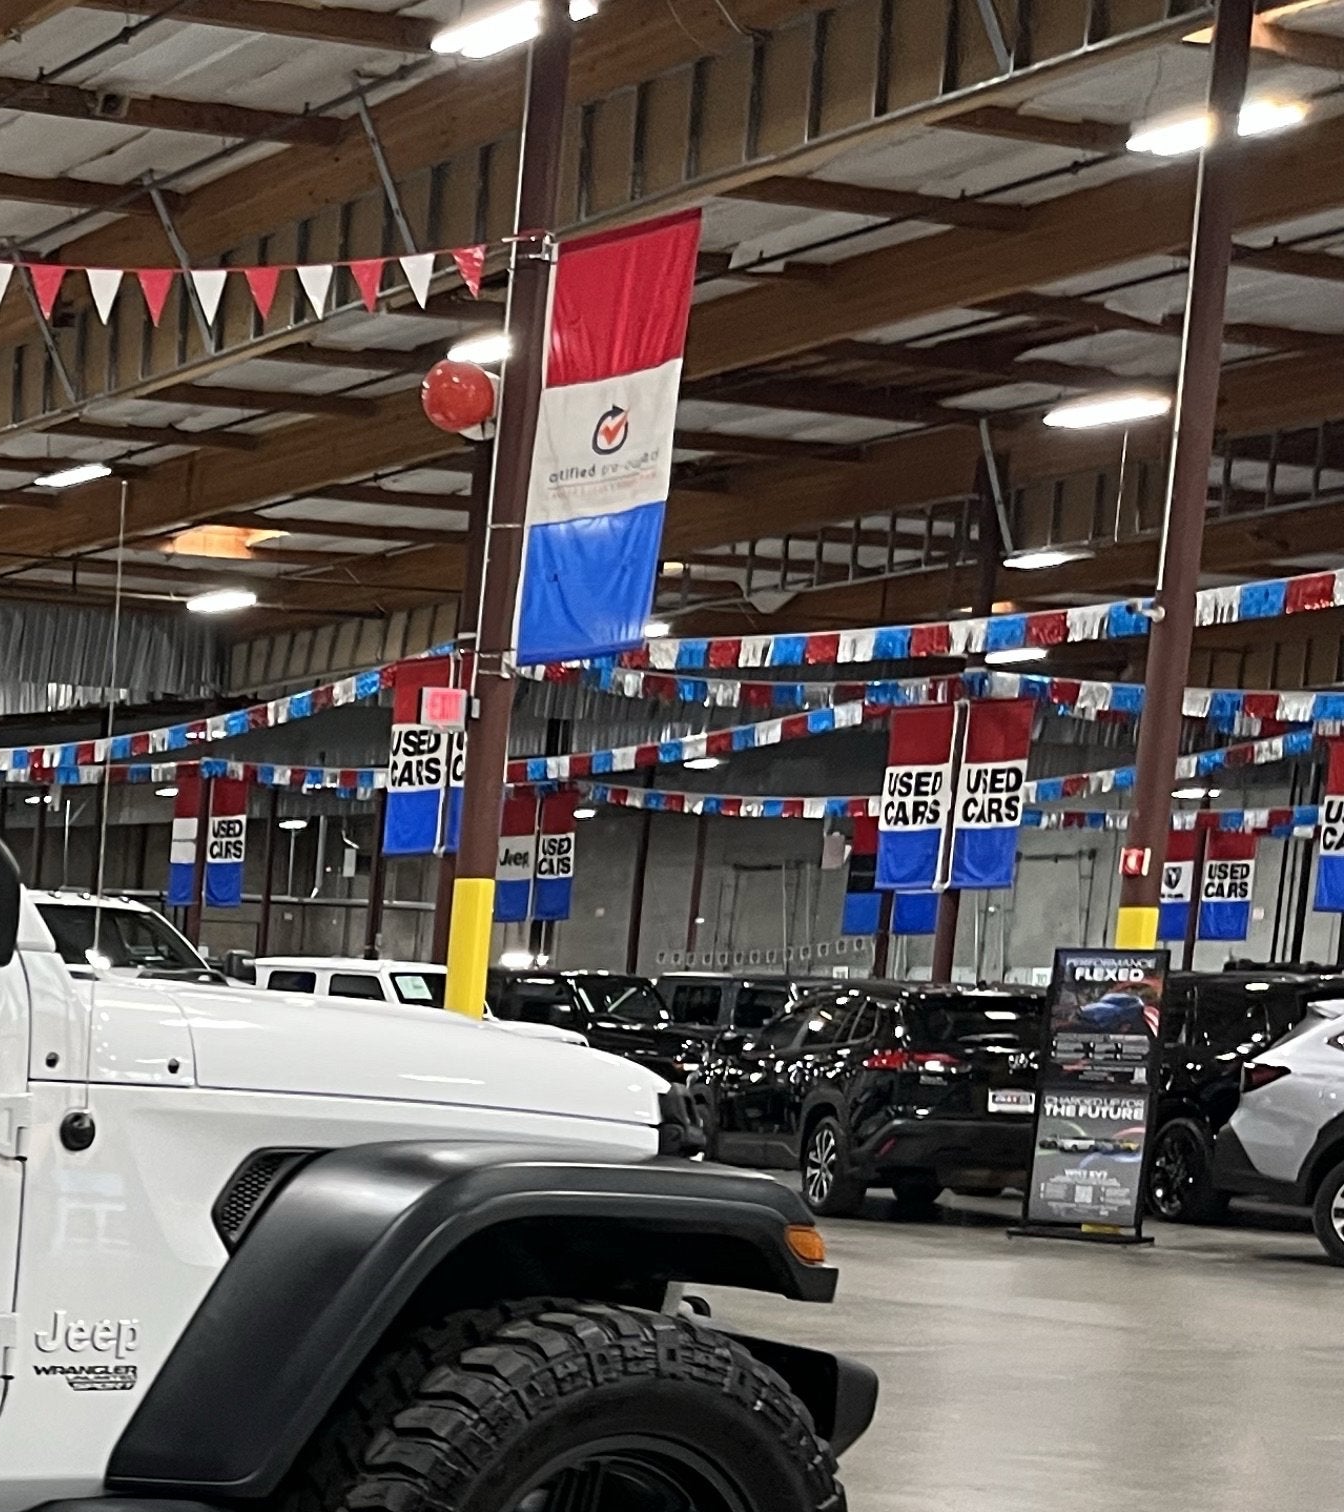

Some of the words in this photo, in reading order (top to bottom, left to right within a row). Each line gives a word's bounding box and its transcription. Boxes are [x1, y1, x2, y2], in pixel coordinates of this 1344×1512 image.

[392, 729, 441, 757] USED
[391, 757, 441, 787] CARS
[889, 771, 943, 797] USED
[966, 767, 1023, 794] USED
[884, 799, 941, 825] CARS
[962, 796, 1020, 823] CARS
[212, 819, 243, 838] USED
[1207, 863, 1250, 880] USED
[1204, 882, 1248, 898] CARS
[1074, 966, 1145, 981] FLEXED
[1044, 1104, 1076, 1117] THE
[1078, 1105, 1145, 1120] FUTURE
[34, 1310, 140, 1360] Jeep
[32, 1365, 138, 1376] WRANGLER
